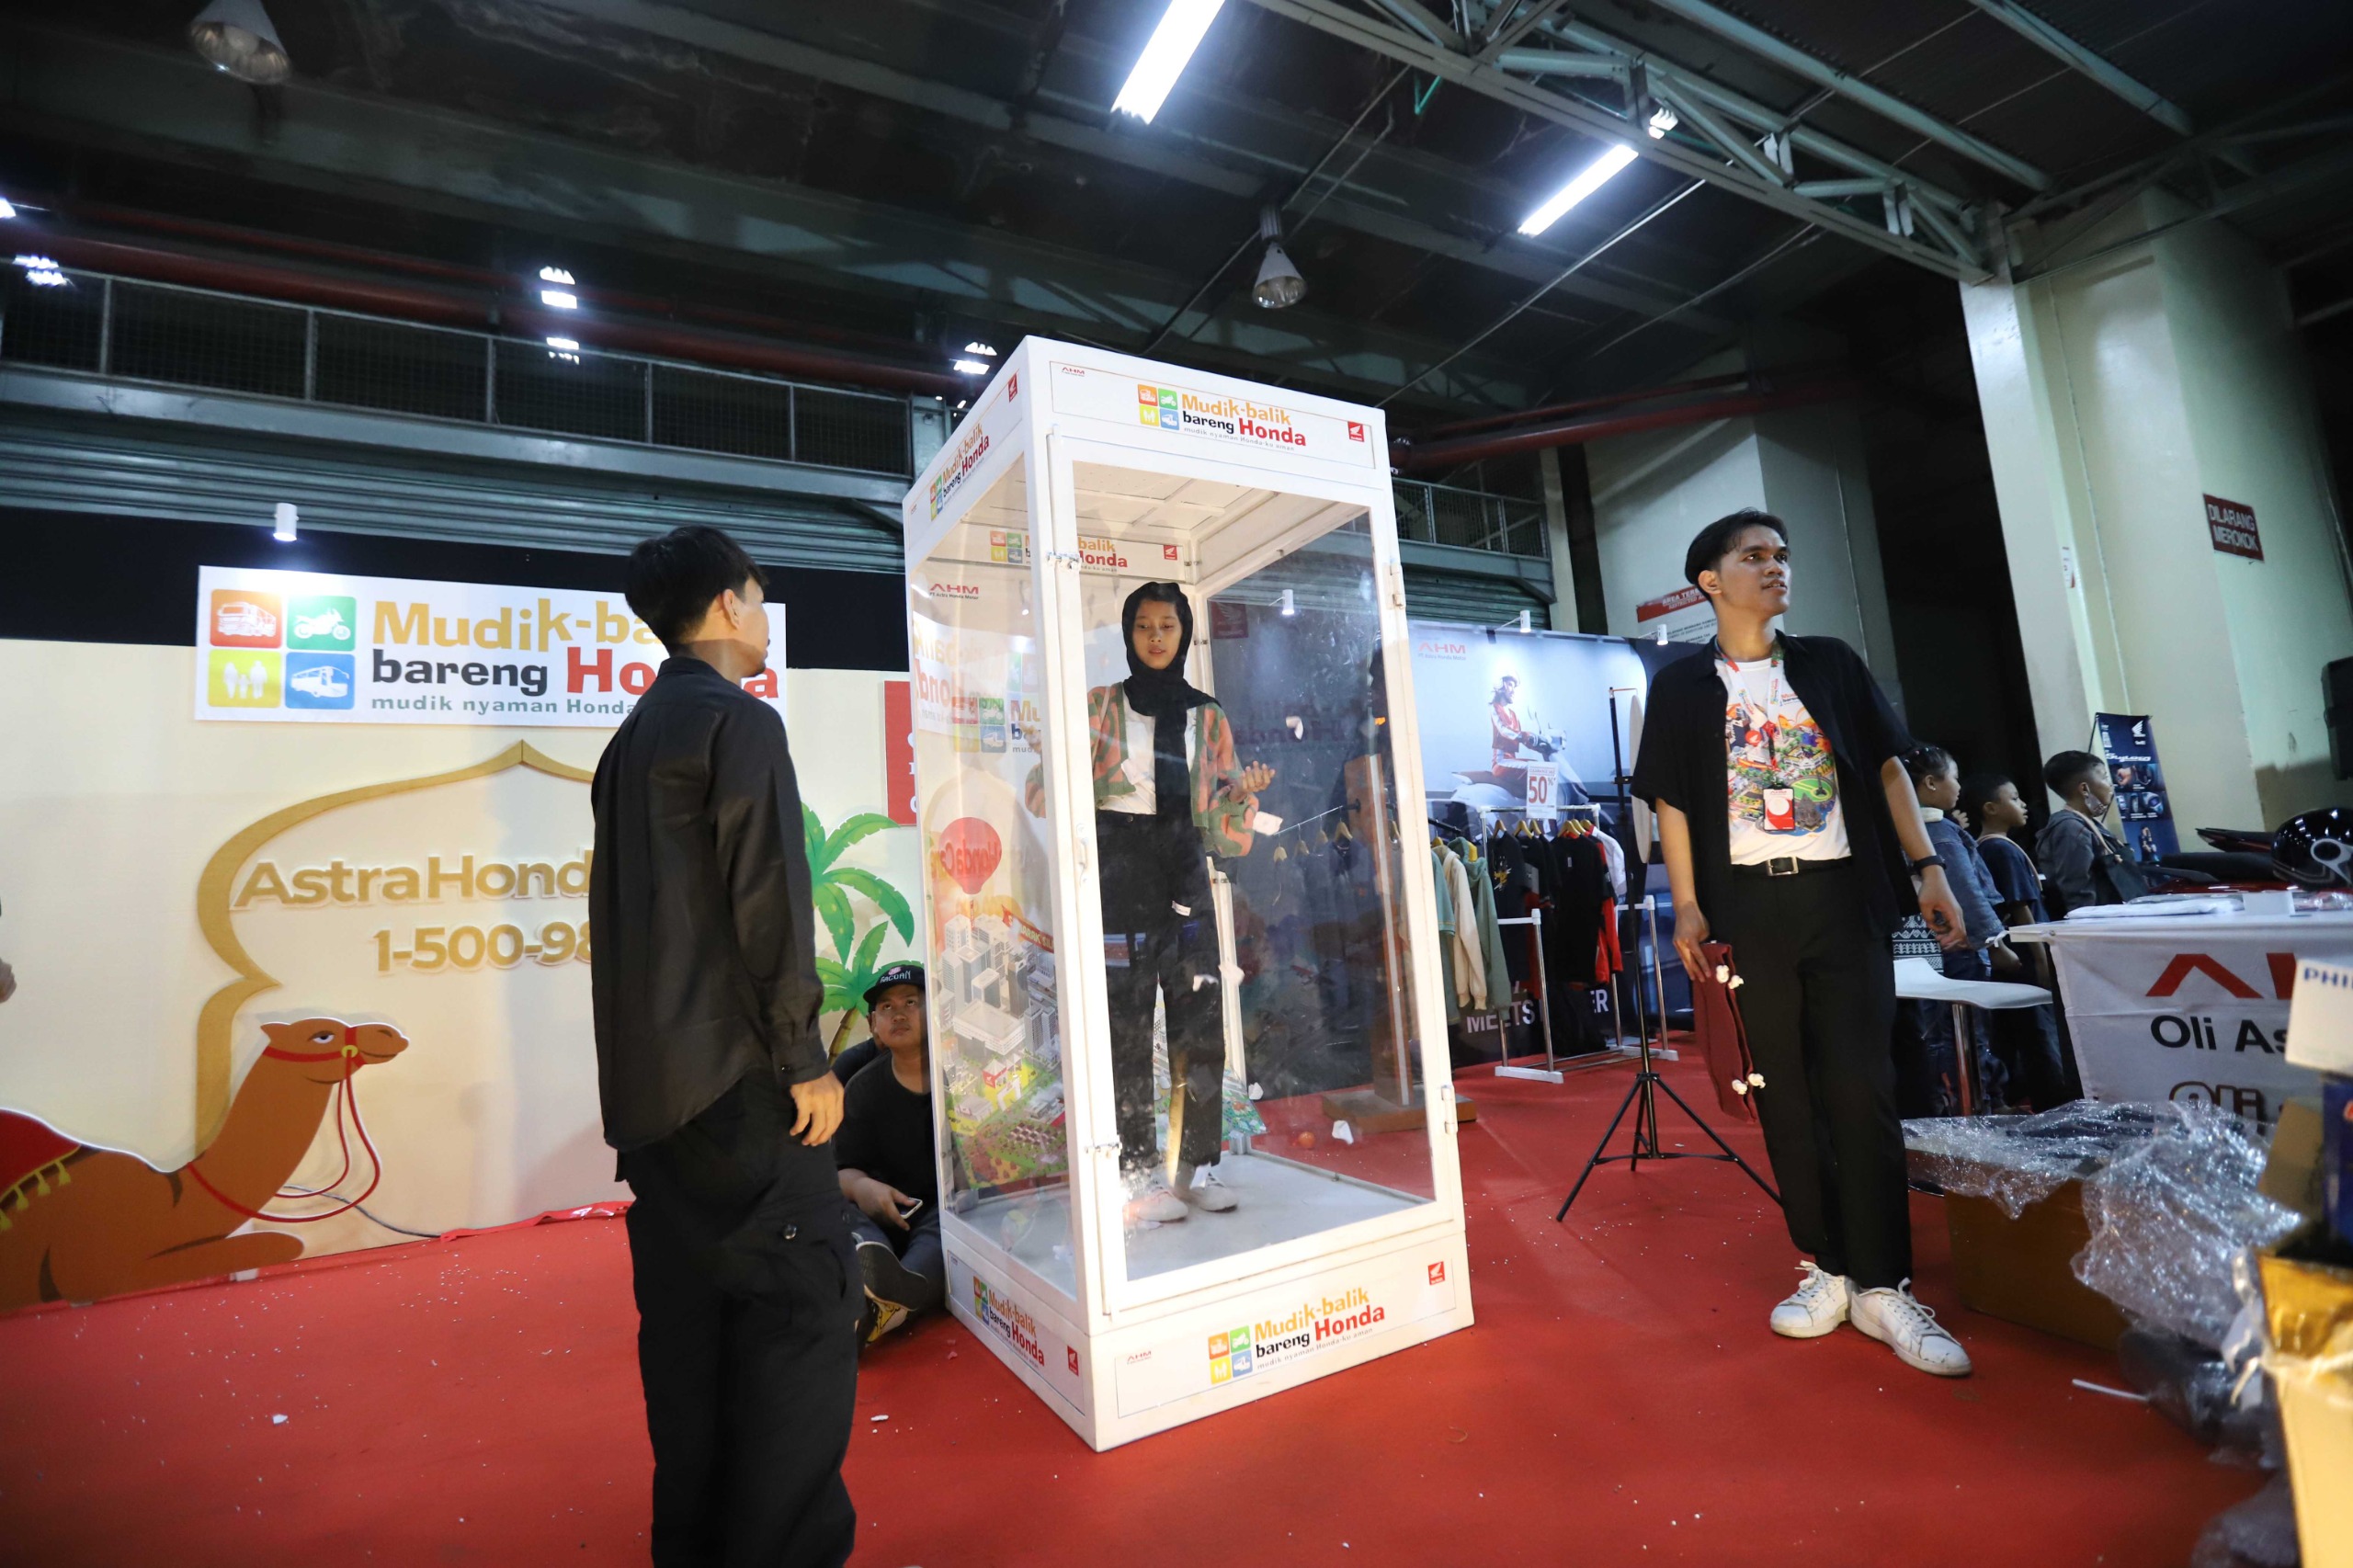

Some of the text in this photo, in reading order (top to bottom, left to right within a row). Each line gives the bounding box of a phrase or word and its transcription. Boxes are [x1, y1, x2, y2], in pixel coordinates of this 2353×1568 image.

[1182, 393, 1292, 426] Mudik-balik
[1183, 411, 1306, 447] bareng Honda
[943, 423, 983, 484] Mudik-balik
[943, 472, 961, 497] bareng
[961, 436, 989, 477] Honda
[2207, 504, 2256, 531] DILARANG
[2212, 525, 2259, 551] MEROKOK
[1079, 551, 1128, 568] onda
[930, 583, 979, 595] AHM
[1662, 595, 1680, 607] AREA
[372, 597, 662, 653] Mudik-ba
[1418, 642, 1466, 654] AHM
[371, 646, 779, 699] bareng Hoa
[371, 694, 636, 715] mudik nyaman Honda
[372, 920, 592, 972] 1-500-98
[1466, 999, 1535, 1034] METS
[2150, 1015, 2288, 1054] Oli As
[988, 1290, 1037, 1338] Mudik-balik
[1255, 1287, 1370, 1343] Mudik-balik
[1256, 1304, 1385, 1358] bareng Honda
[990, 1306, 1011, 1338] bareng
[1011, 1321, 1045, 1367] Honda
